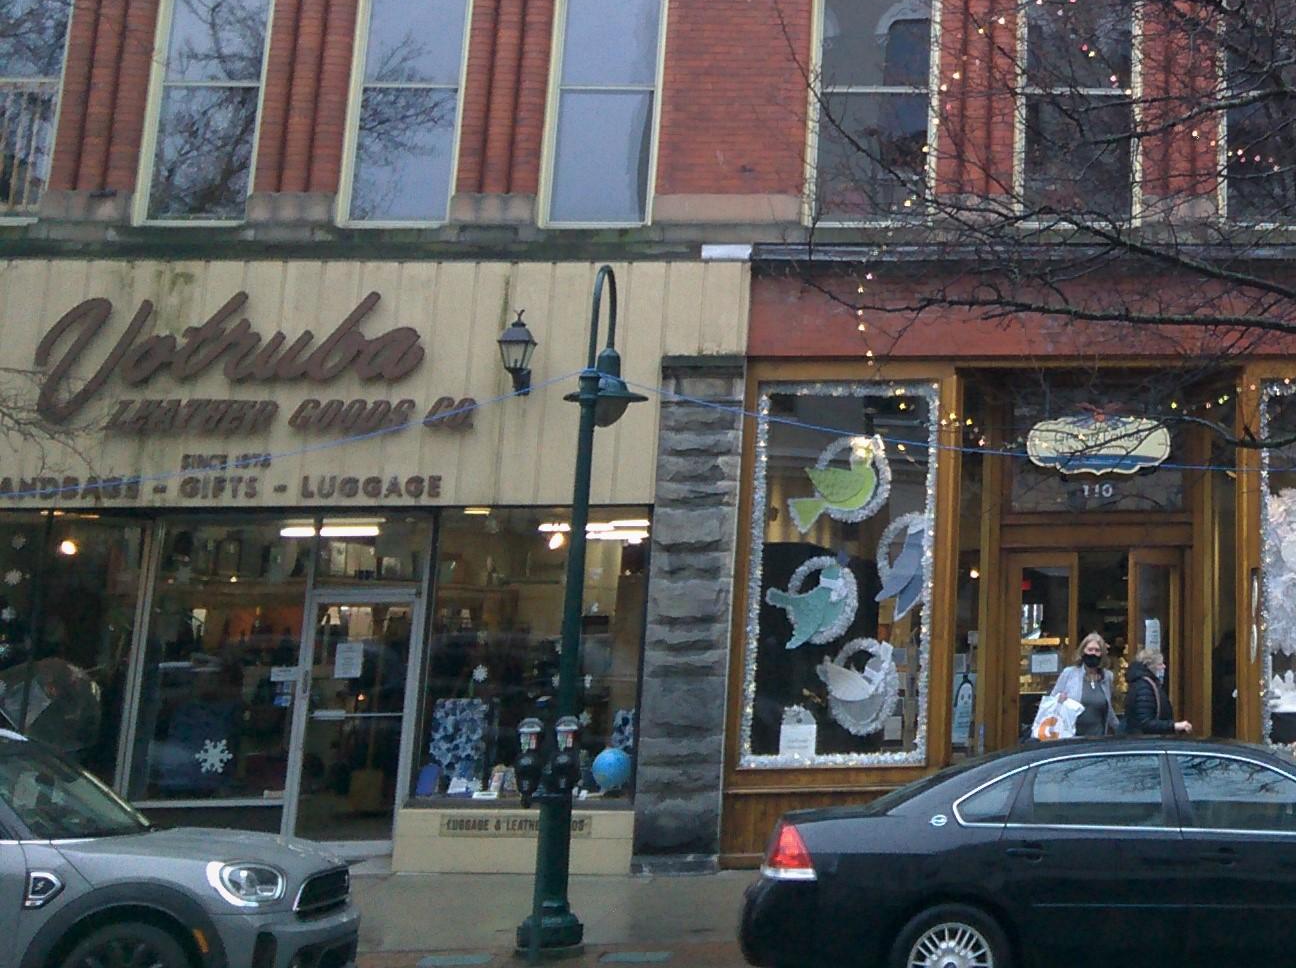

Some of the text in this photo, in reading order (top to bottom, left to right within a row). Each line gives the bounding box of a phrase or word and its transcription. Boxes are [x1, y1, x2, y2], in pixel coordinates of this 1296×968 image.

[35, 290, 425, 424] Votruba
[101, 398, 279, 434] LEATHER
[288, 398, 417, 431] GOODS
[180, 476, 257, 499] GIFTS
[301, 475, 442, 499] LUGGAGE
[506, 819, 540, 831] LEATHE
